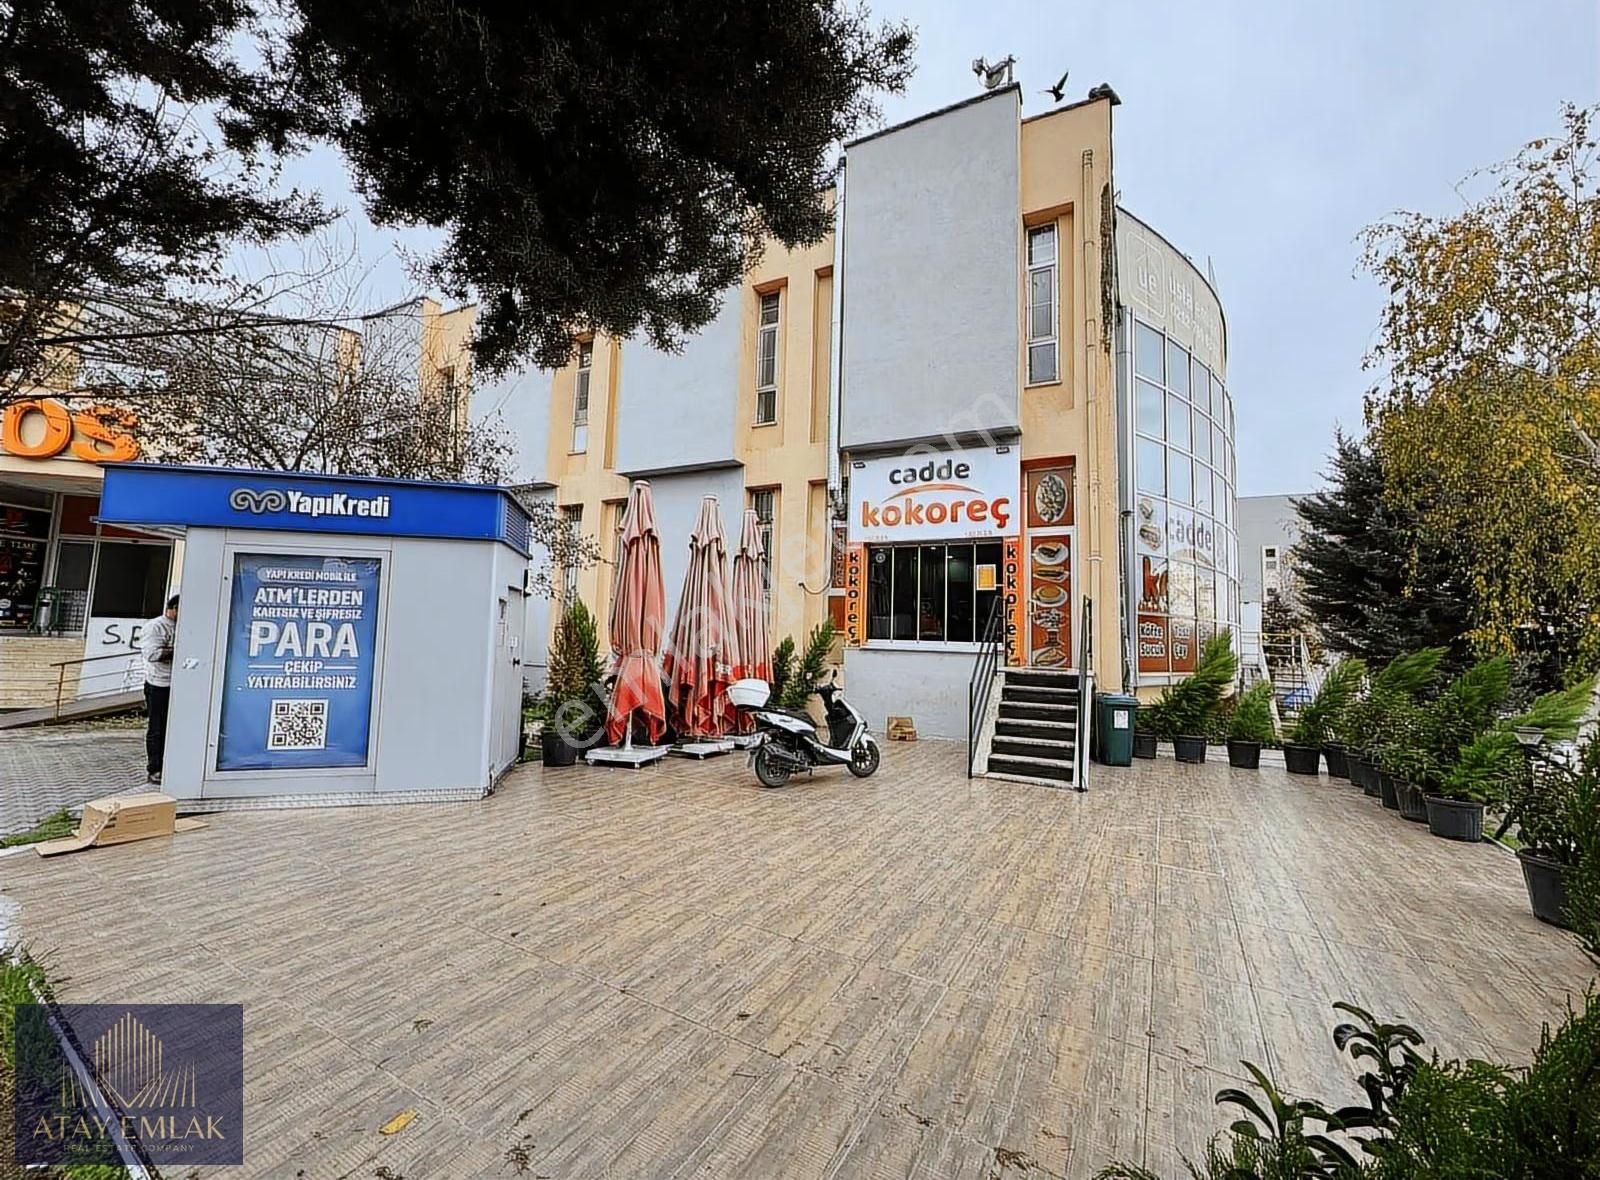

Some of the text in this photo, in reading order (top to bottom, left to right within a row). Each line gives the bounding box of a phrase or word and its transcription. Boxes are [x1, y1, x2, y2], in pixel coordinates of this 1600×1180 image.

[889, 459, 971, 484] cadde
[287, 491, 390, 517] YapıKredi
[862, 498, 1010, 529] kokoreç
[265, 569, 286, 580] YAPI
[254, 587, 363, 606] ATM'LERDEN
[847, 552, 859, 639] kokoreç
[1006, 544, 1017, 656] kokoreç
[300, 607, 314, 618] VE
[249, 621, 359, 658] PARA
[283, 661, 323, 675] ÇEKİP
